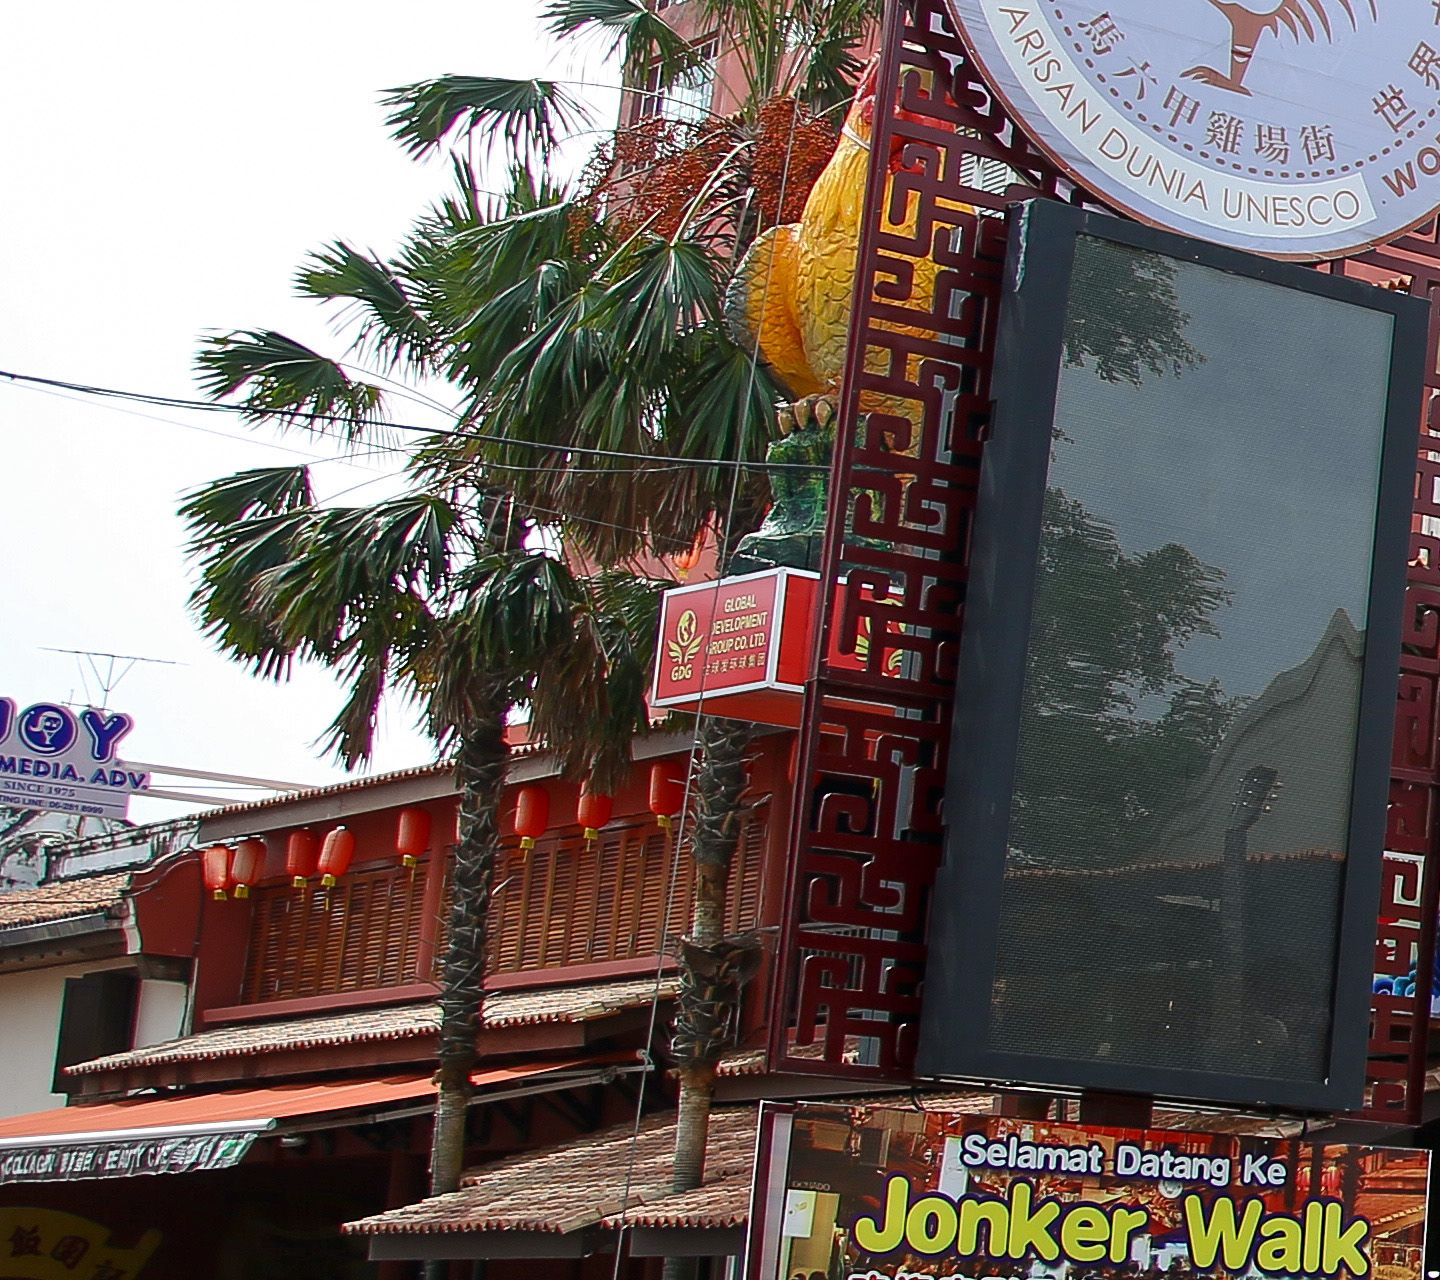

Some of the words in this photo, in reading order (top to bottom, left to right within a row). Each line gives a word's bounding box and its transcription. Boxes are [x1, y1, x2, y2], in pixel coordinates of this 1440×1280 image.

[1077, 10, 1337, 166] 馬六甲雞場街
[1097, 126, 1210, 212] DUNIA
[1221, 186, 1362, 227] UNESCO
[724, 593, 757, 614] GLOBAL
[749, 631, 766, 649] LTD.
[670, 662, 693, 683] GDG
[4, 780, 45, 795] SINCE
[47, 785, 76, 799] 1975
[90, 767, 149, 791] ADV.
[959, 1134, 1103, 1177] Selamat
[1116, 1143, 1231, 1188] Datang
[1242, 1152, 1288, 1187] Ke
[853, 1175, 1149, 1266] Jonker
[1182, 1190, 1372, 1277] Walk
